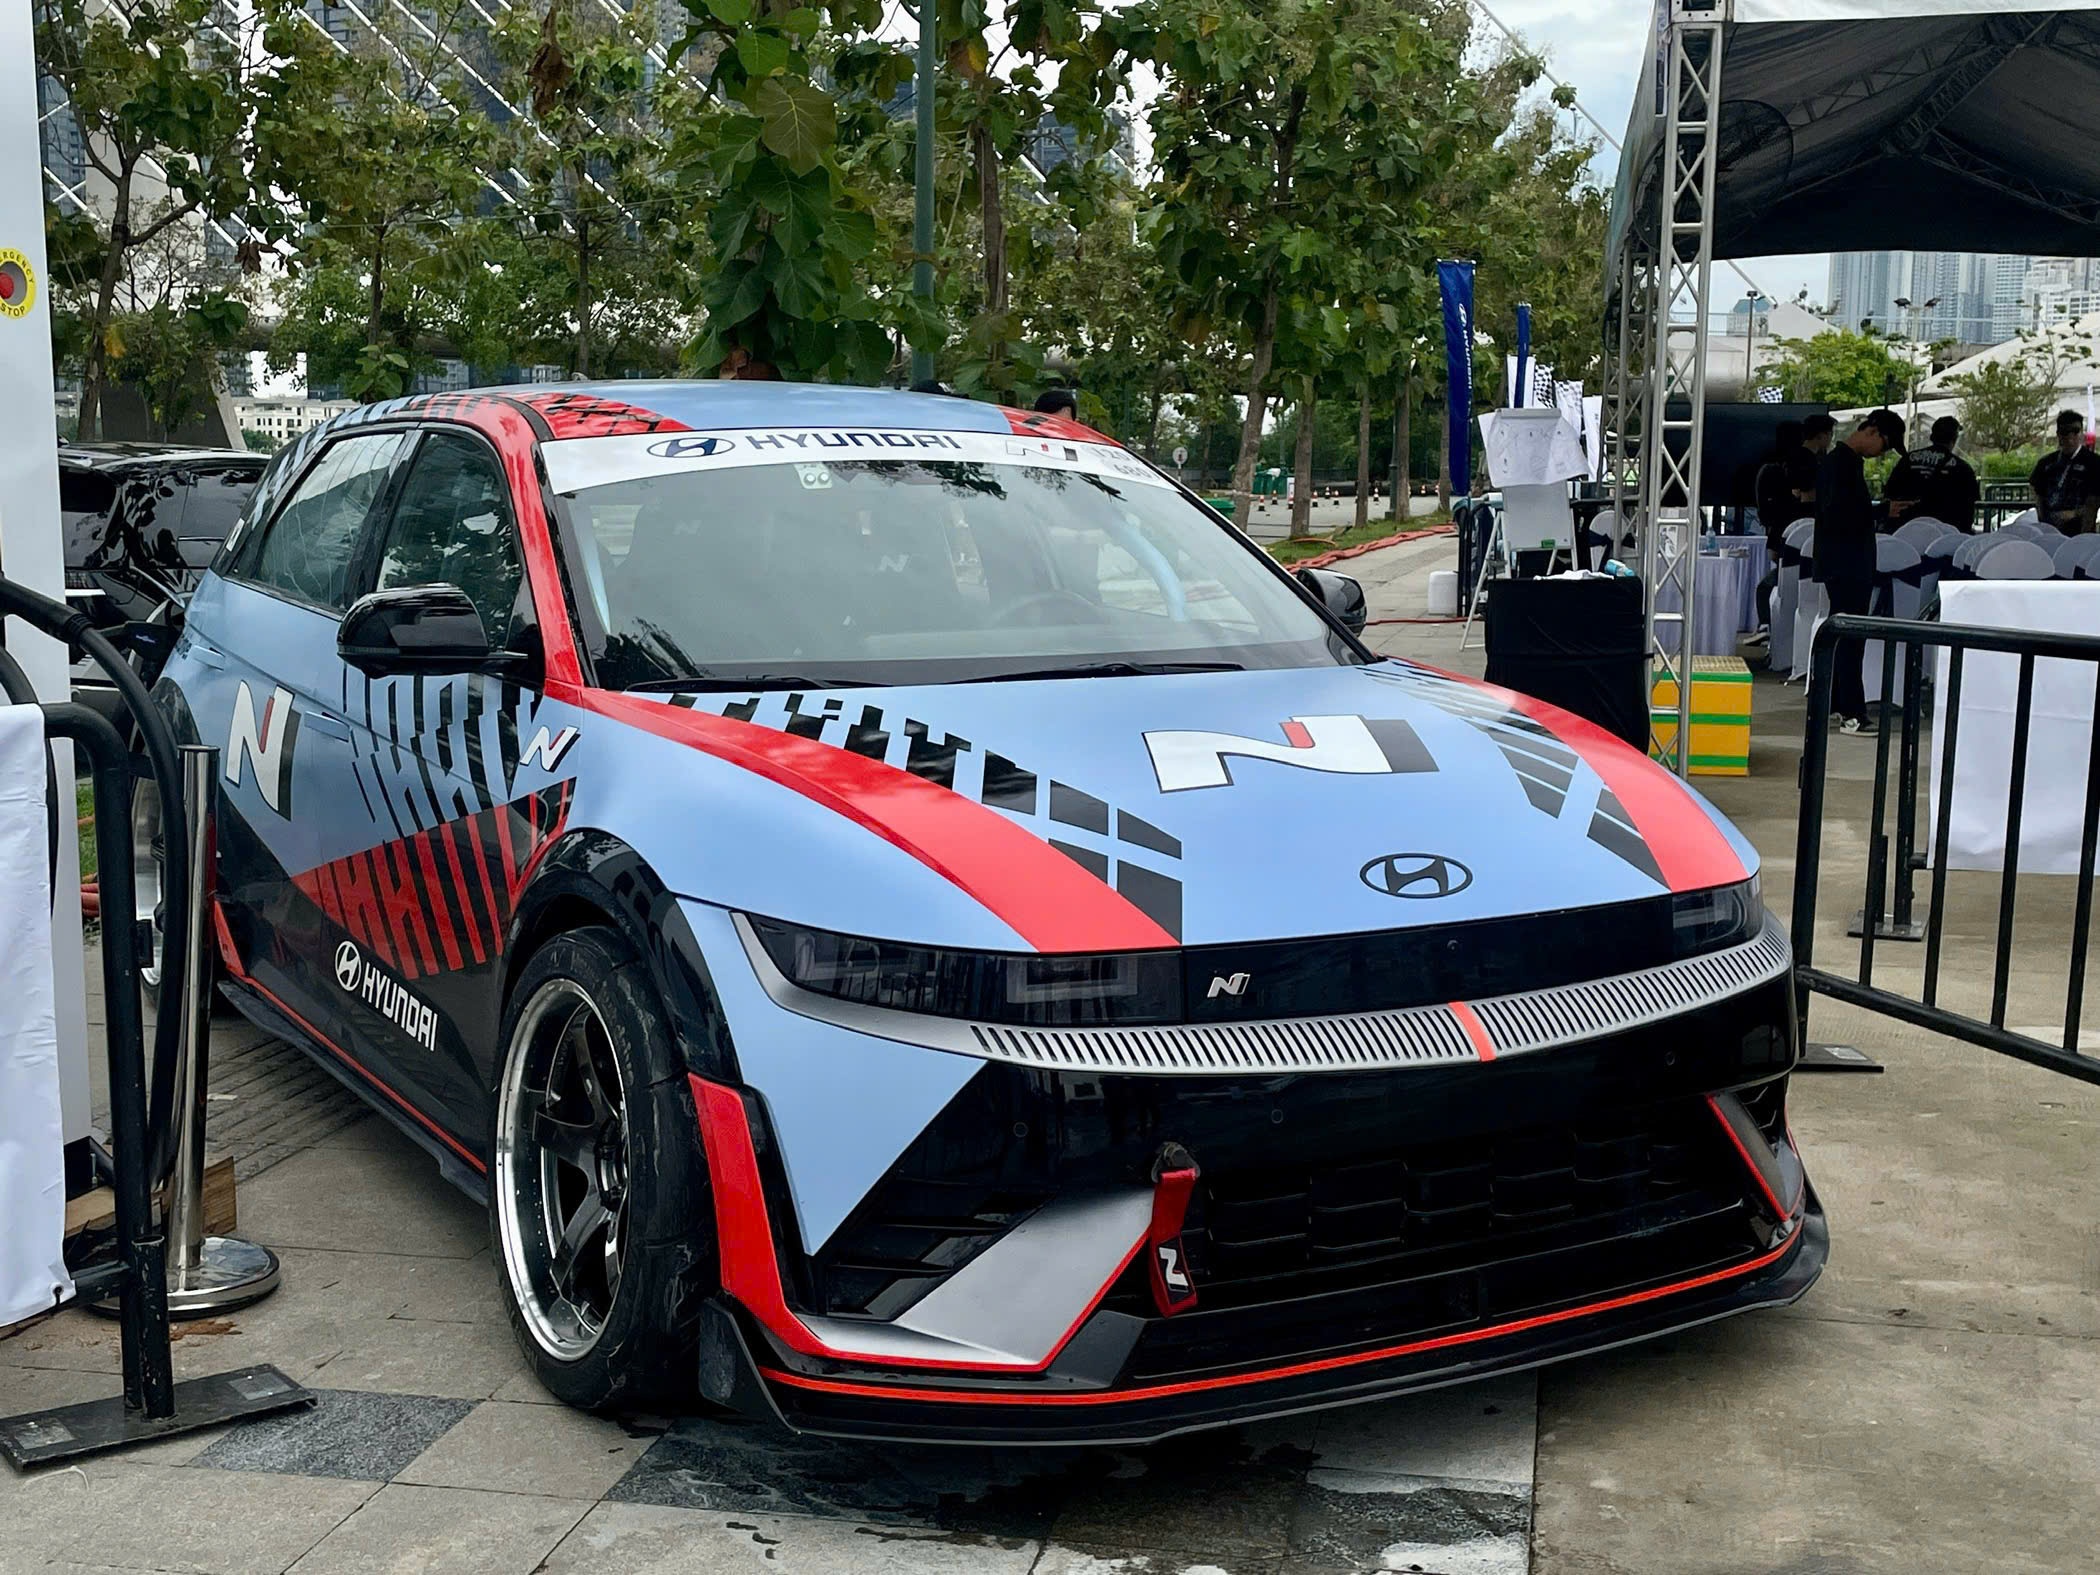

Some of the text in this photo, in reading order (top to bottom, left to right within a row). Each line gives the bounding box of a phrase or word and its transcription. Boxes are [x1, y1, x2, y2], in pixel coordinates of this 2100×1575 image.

[0, 252, 34, 283] RGENCY
[1, 304, 25, 317] STOP
[746, 432, 961, 451] HYUNDAI
[226, 680, 301, 820] N
[520, 725, 581, 772] N
[1141, 714, 1439, 793] N
[1207, 973, 1251, 998] N
[362, 962, 438, 1051] HYUNDAI
